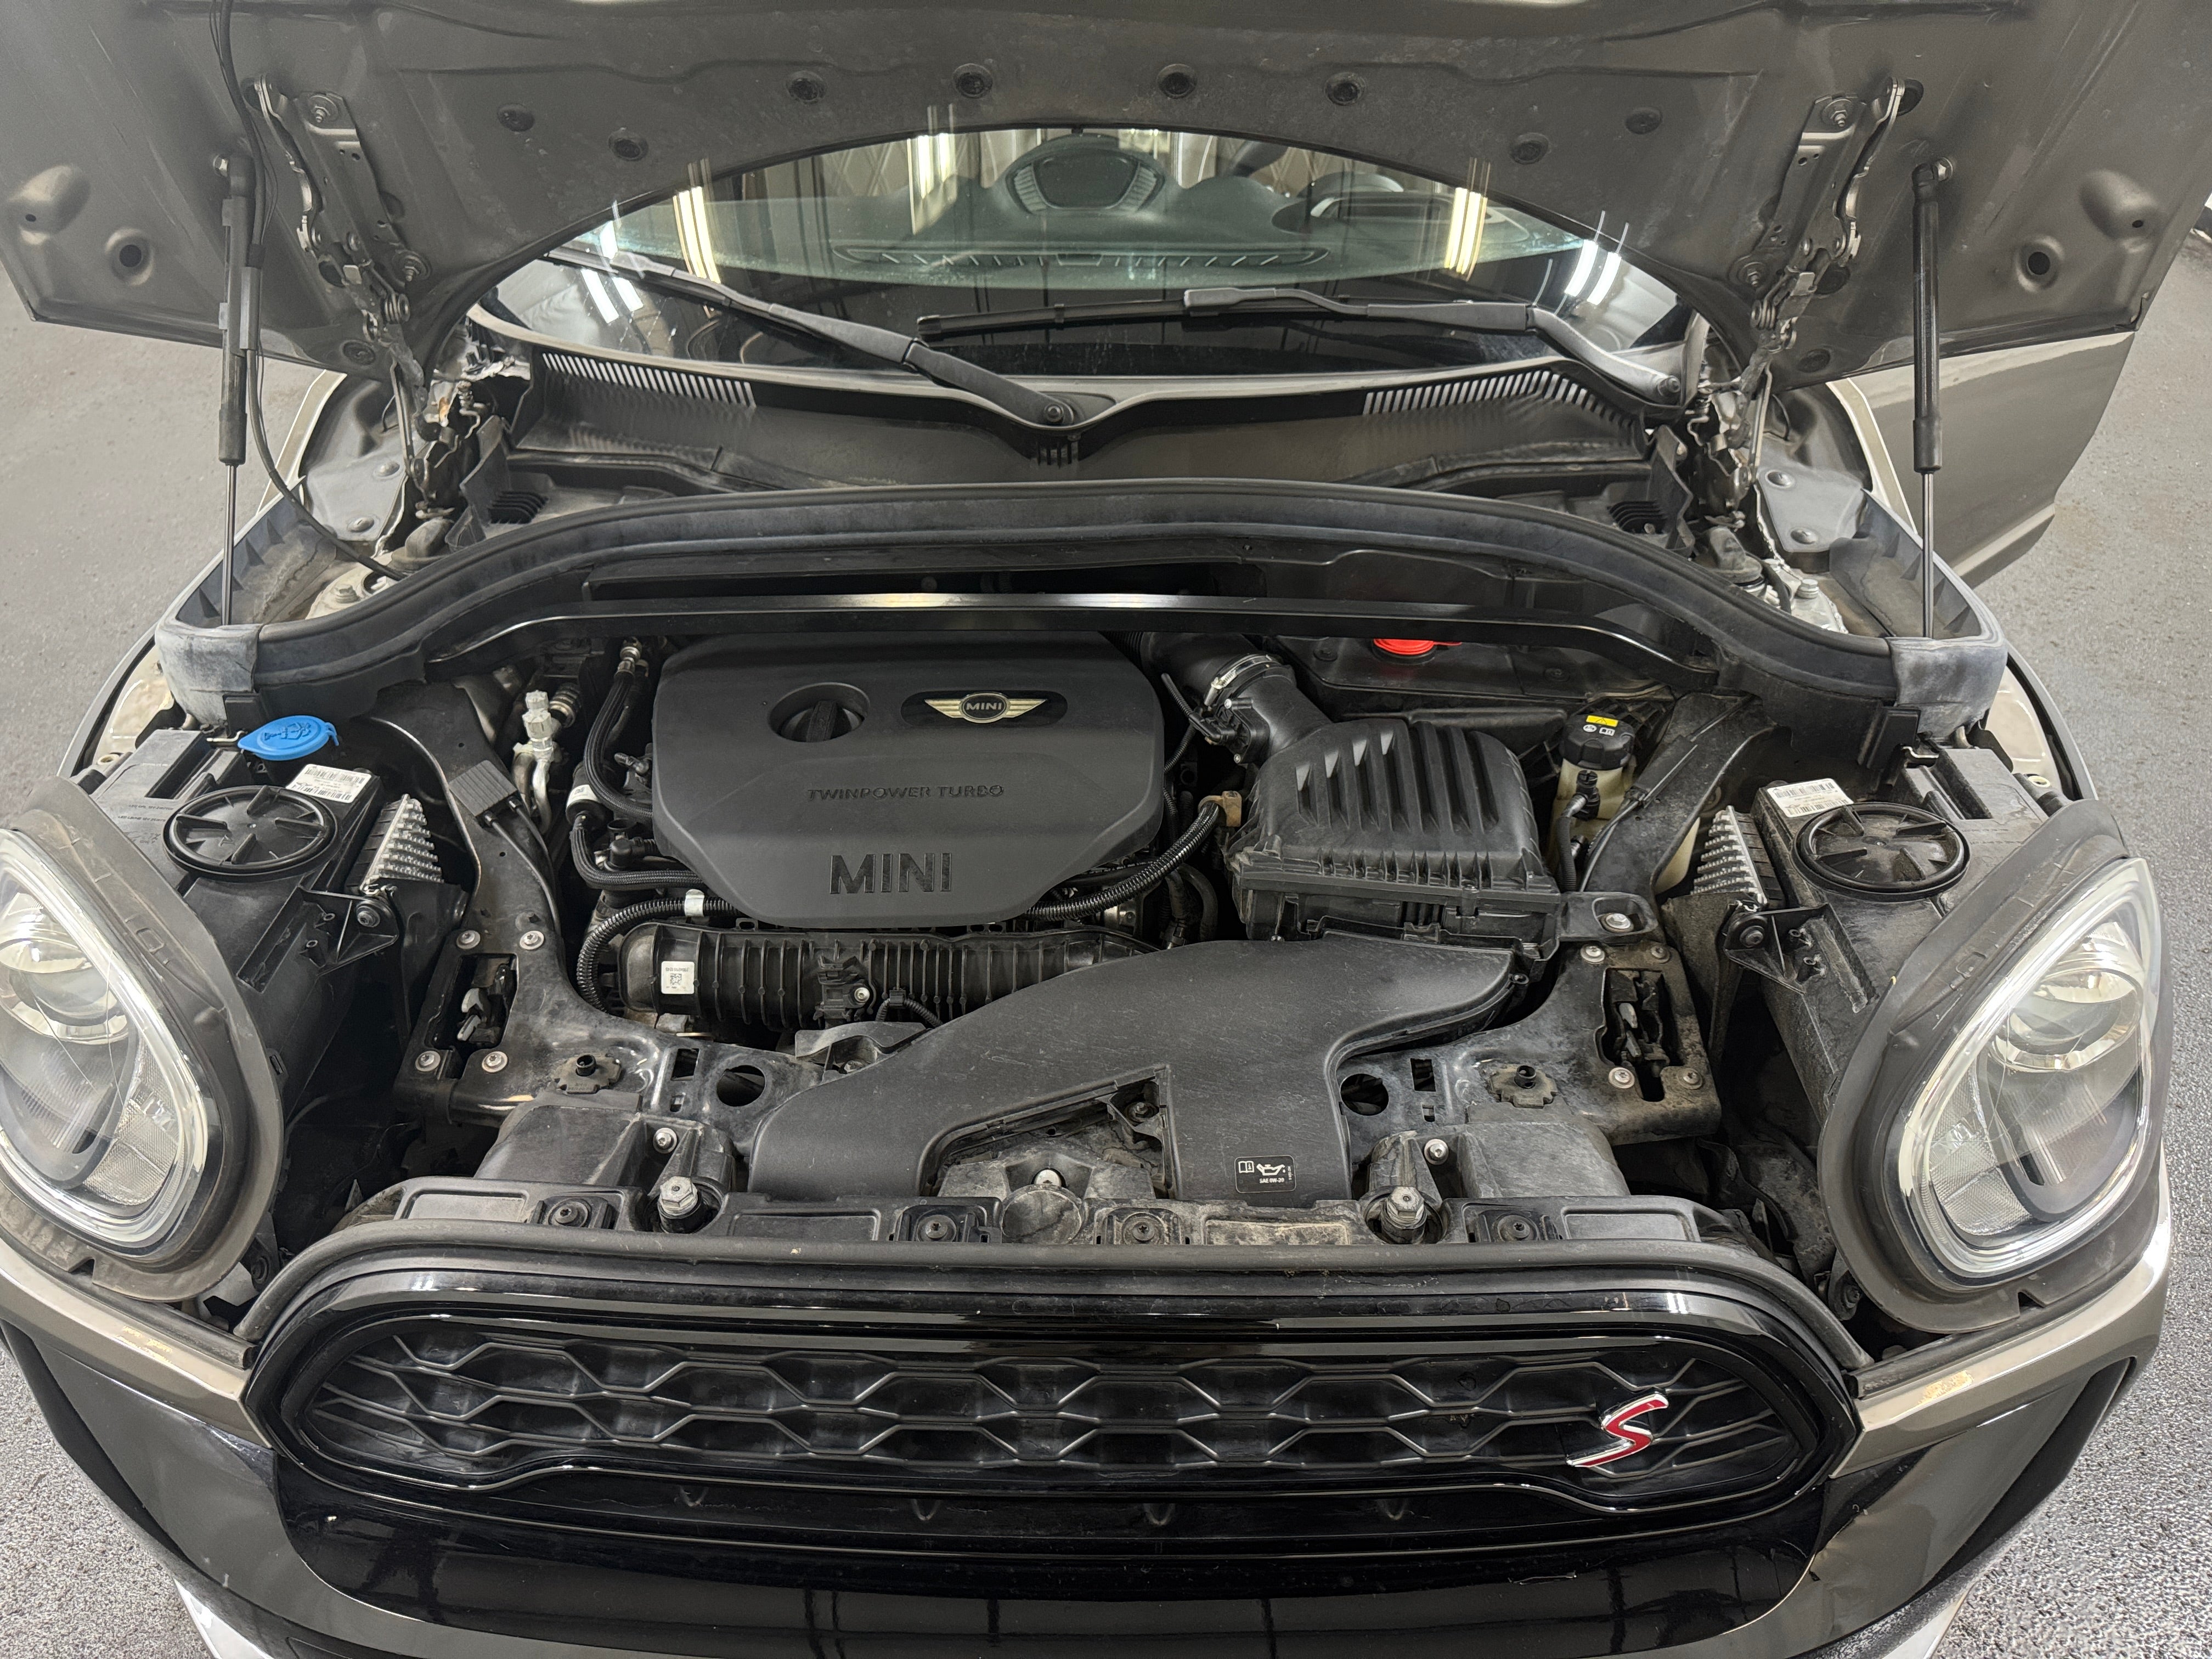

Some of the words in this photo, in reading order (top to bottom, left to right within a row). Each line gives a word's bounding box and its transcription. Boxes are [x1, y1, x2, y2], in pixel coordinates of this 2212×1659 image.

[966, 702, 1002, 710] MINI
[808, 786, 930, 800] TWINPOWER
[937, 785, 1005, 798] TURBO
[830, 853, 952, 894] MINI
[1566, 1392, 1669, 1468] S
